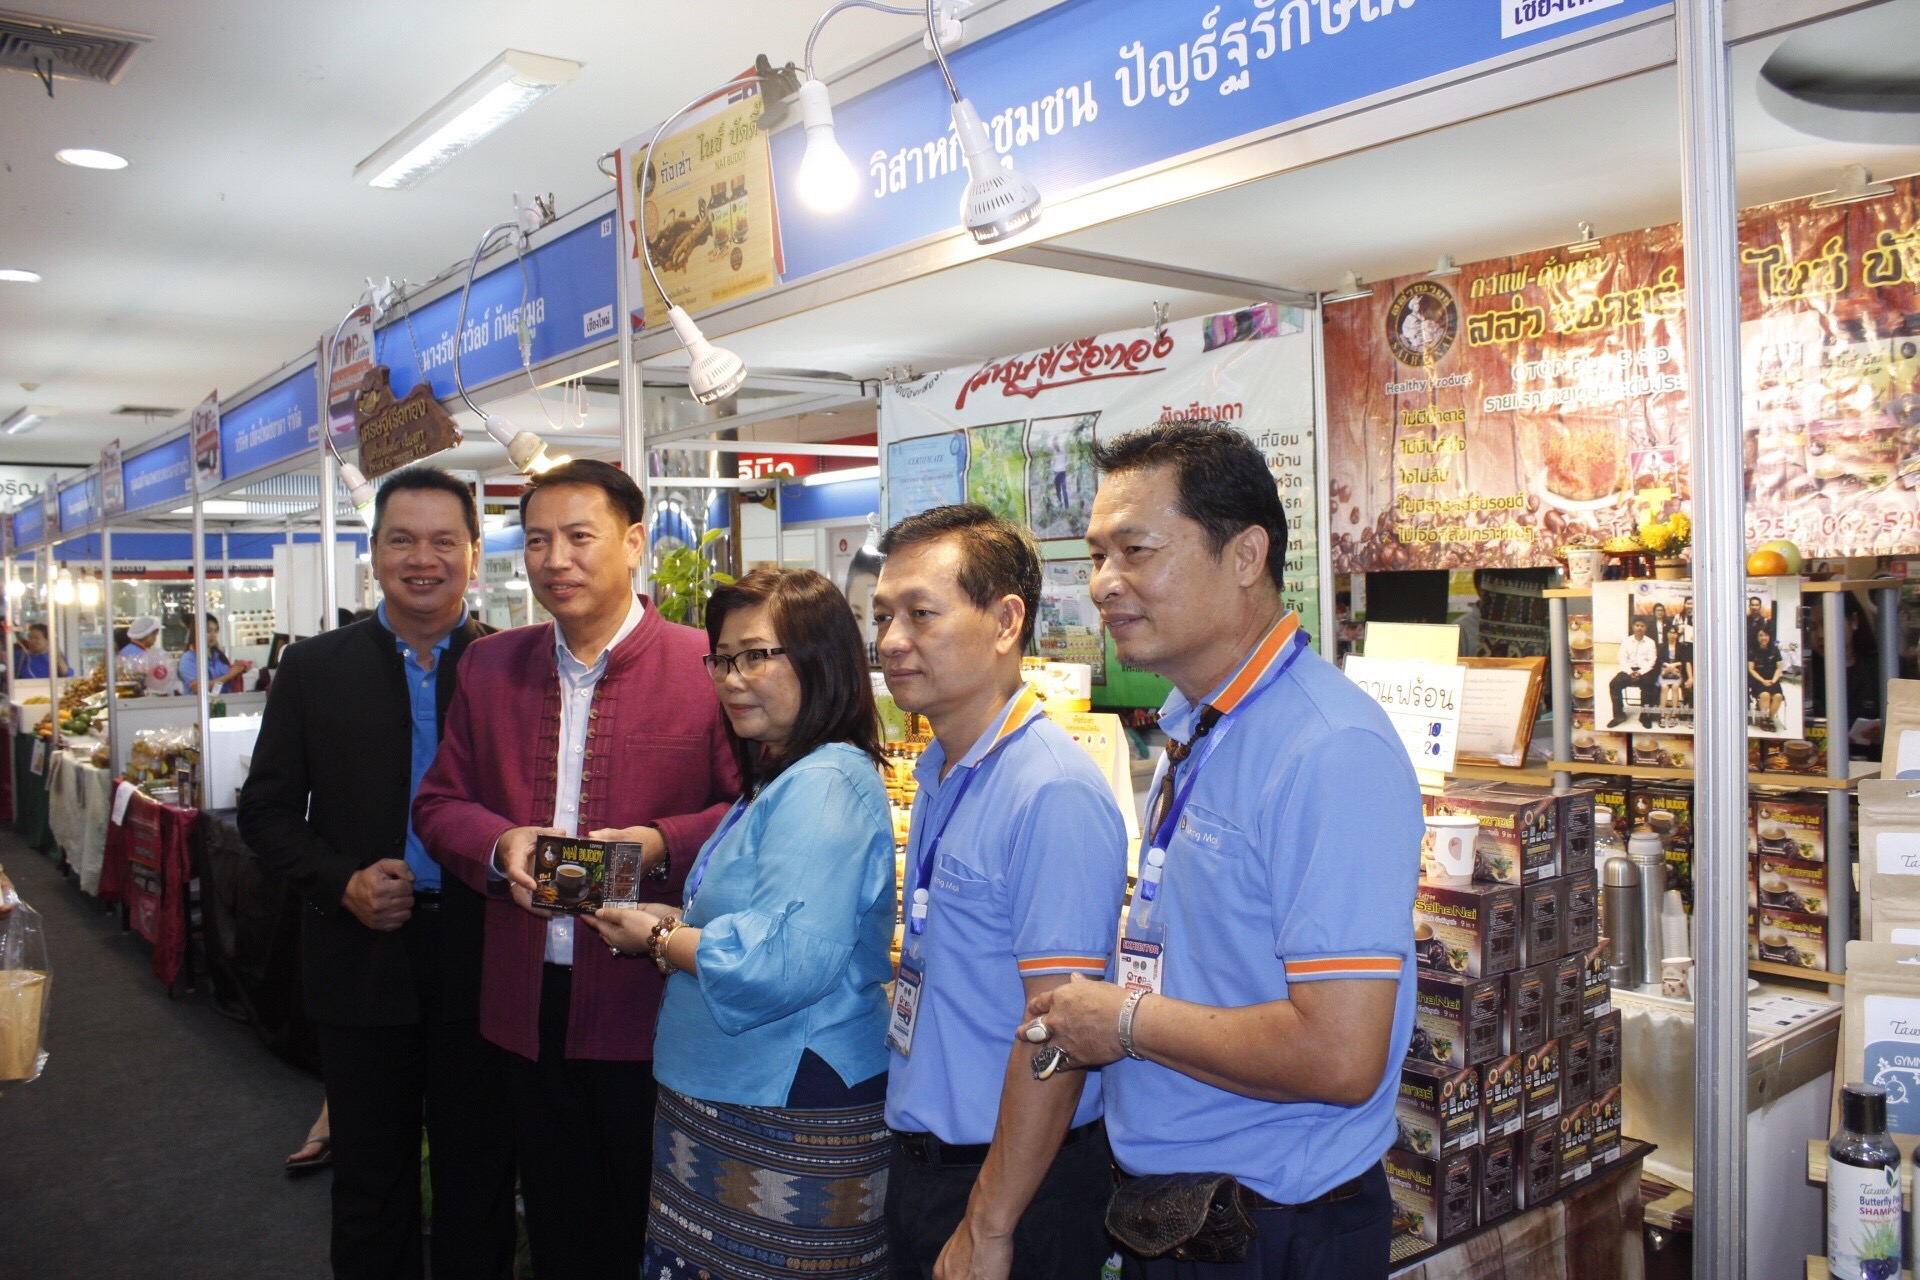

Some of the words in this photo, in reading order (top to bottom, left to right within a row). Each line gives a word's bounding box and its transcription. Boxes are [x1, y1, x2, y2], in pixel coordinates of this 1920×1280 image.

[728, 149, 746, 166] BUDDY
[421, 308, 489, 371] นางรัชาวัลย์
[1385, 379, 1427, 395] Healthy
[562, 845, 578, 860] NAI
[579, 848, 605, 863] BUDDY
[1415, 900, 1477, 920] SalhaNai
[1122, 939, 1160, 955] EXHIBITOR
[1859, 1195, 1891, 1207] Butterfly
